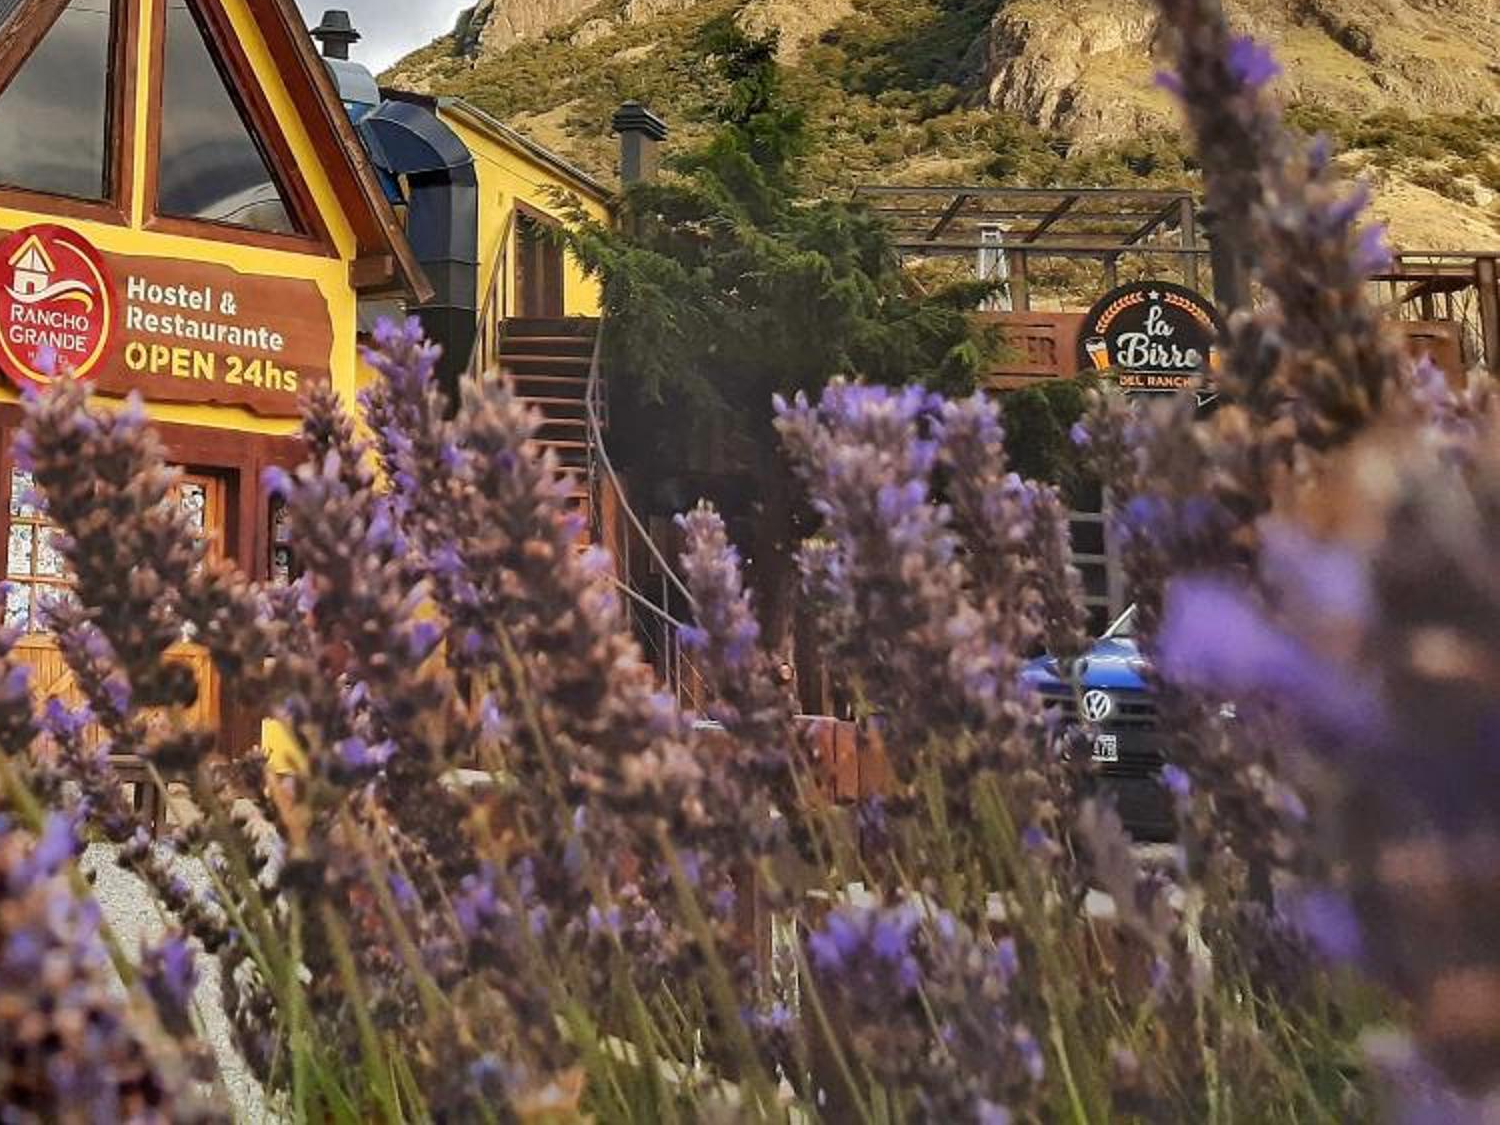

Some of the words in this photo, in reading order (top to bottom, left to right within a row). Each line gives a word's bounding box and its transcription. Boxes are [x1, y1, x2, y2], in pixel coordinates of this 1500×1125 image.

[126, 275, 211, 313] Hostel
[219, 291, 237, 316] &
[10, 303, 90, 332] RANCHO
[126, 304, 285, 352] Restaurante
[1143, 305, 1175, 337] la
[9, 324, 88, 353] GRANDE
[125, 340, 216, 381] OPEN
[224, 355, 299, 393] 24hs
[1119, 375, 1145, 388] DEL
[1146, 376, 1198, 388] RANCH
